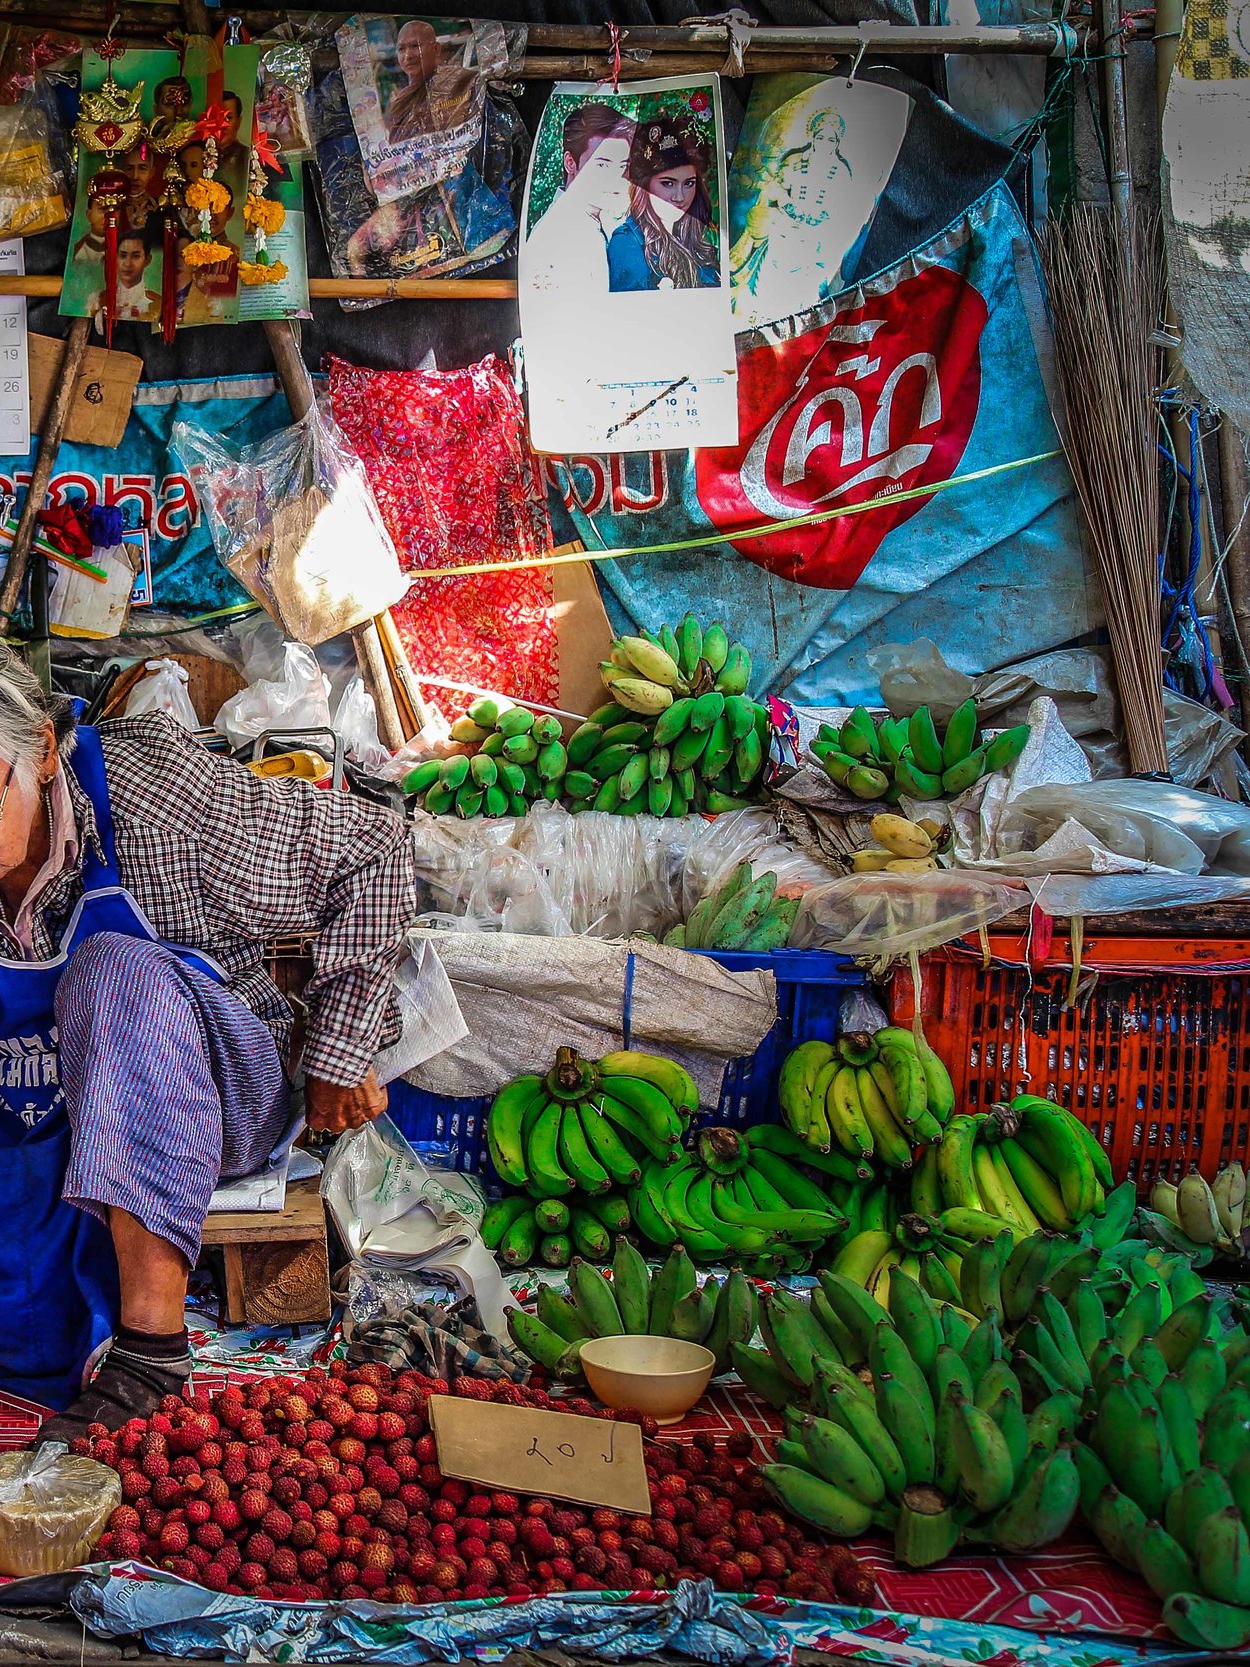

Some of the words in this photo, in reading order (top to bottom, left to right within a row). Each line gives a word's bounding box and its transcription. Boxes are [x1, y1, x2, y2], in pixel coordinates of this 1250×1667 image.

[2, 317, 17, 329] 12
[3, 349, 19, 360] 19
[3, 381, 20, 393] 26
[690, 385, 698, 393] 4
[665, 398, 677, 406] 10
[686, 408, 698, 416] 18
[12, 414, 21, 425] 3
[131, 589, 146, 601] 5
